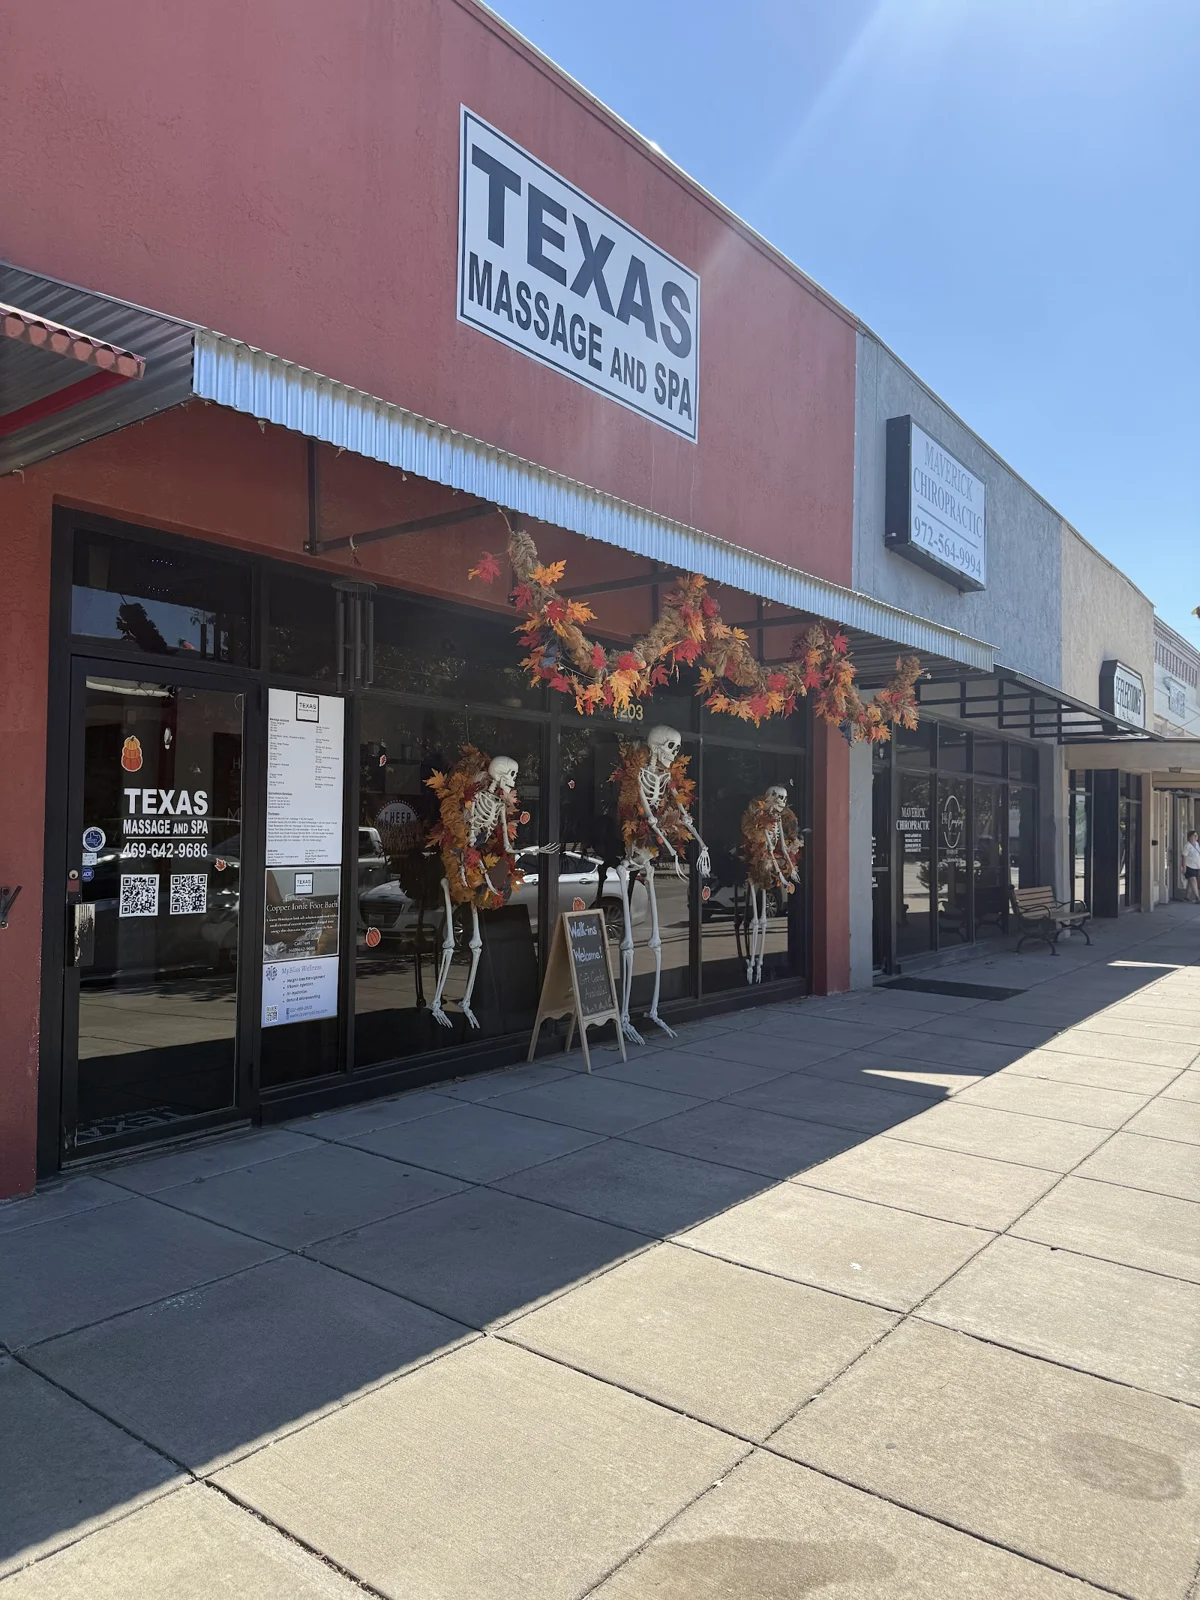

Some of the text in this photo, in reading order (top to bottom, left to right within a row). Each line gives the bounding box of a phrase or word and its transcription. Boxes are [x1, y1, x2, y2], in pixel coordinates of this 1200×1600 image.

[471, 142, 692, 359] TEXAS
[468, 250, 693, 421] MASSAGE AND SPA
[924, 441, 973, 501] MAVERICK
[913, 467, 983, 539] CHIROPRACTIC
[914, 516, 982, 577] 972-564-9994
[124, 788, 208, 816] TEXAS
[384, 811, 412, 824] CHEER
[901, 806, 926, 818] MAVERICK
[123, 819, 209, 834] MASSAGE AND SPA
[895, 819, 931, 831] CHIROPRACTIC
[122, 842, 208, 858] 469-642-9686
[266, 900, 338, 914] Copper Ionic Foot Bath
[567, 921, 598, 938] Walk-ins
[573, 946, 603, 962] Welcome!
